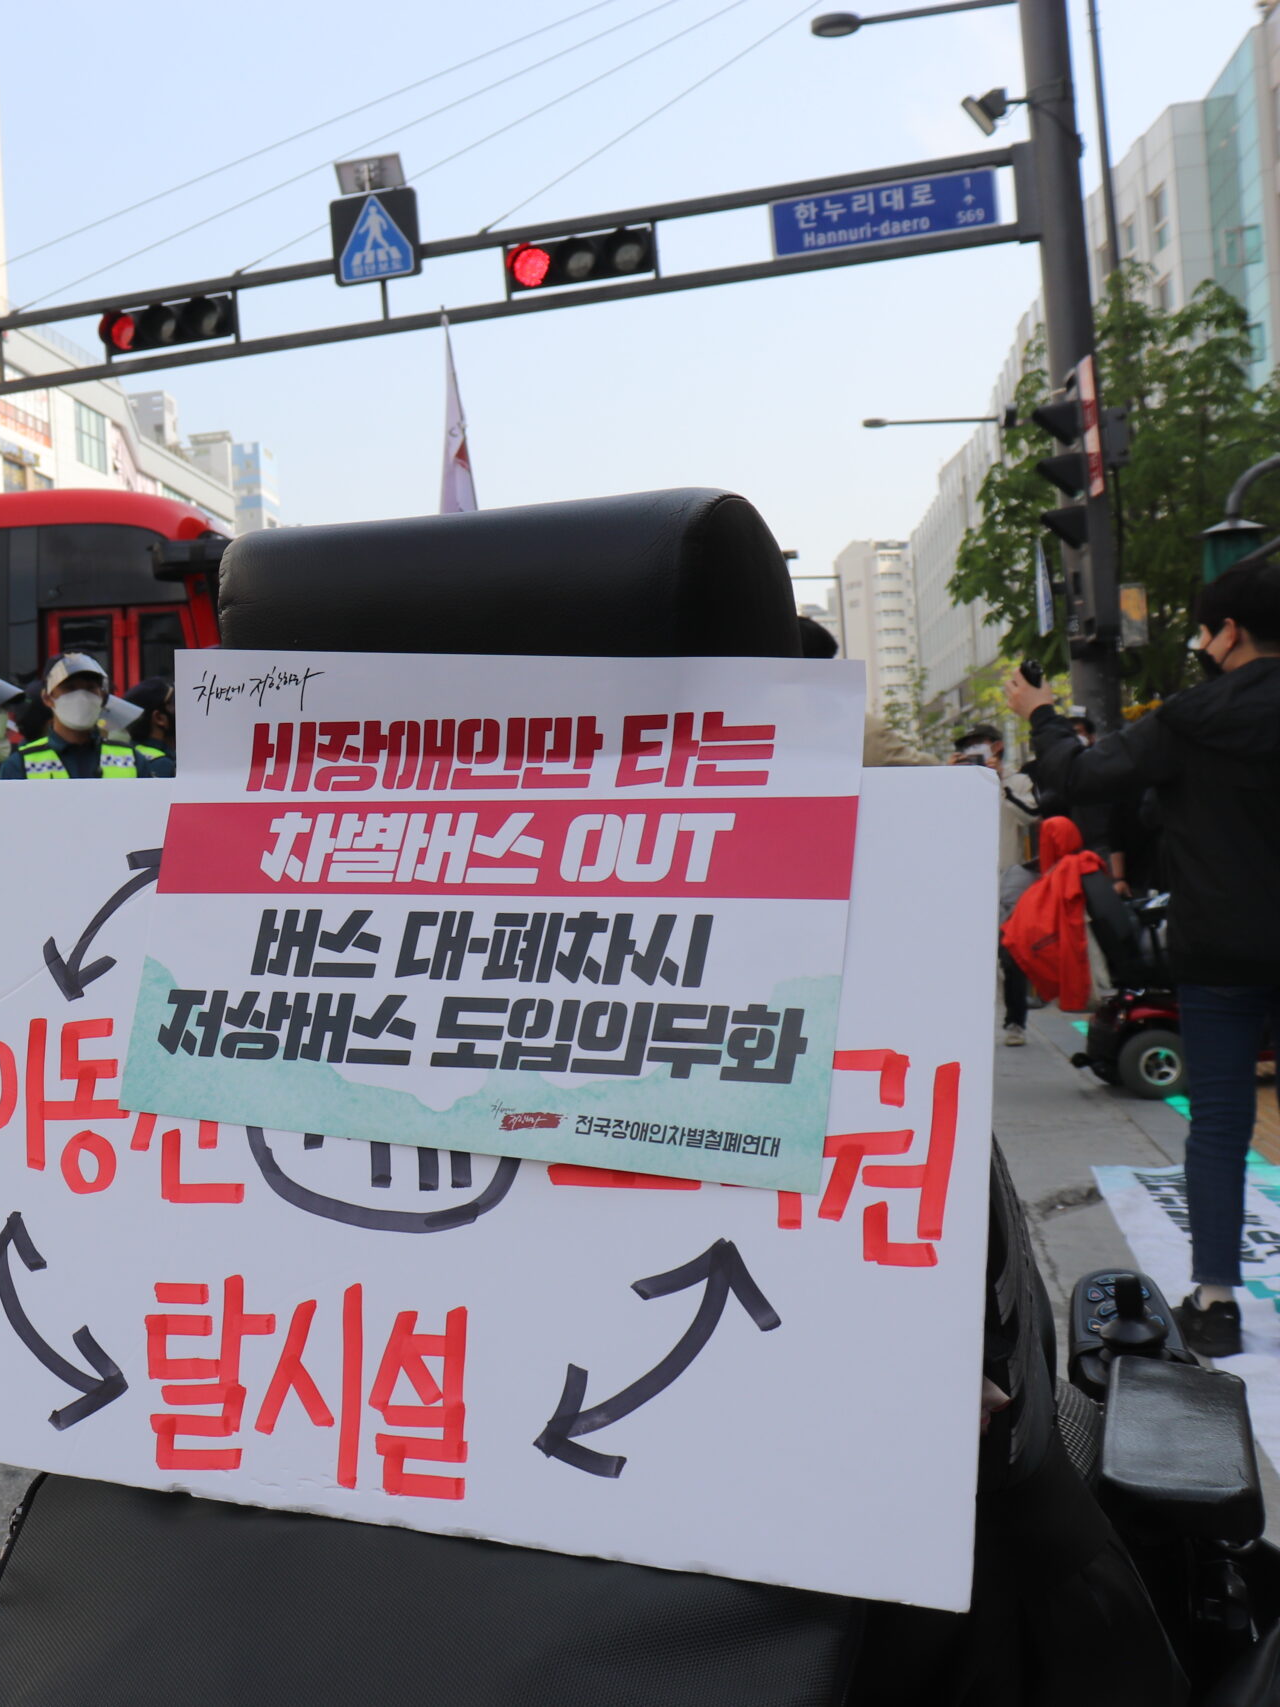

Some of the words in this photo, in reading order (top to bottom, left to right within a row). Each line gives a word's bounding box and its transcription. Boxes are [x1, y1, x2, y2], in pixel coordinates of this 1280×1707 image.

[793, 183, 936, 229] 한누리대로
[802, 216, 930, 249] Hannuri-daero
[956, 207, 986, 225] 569
[246, 715, 604, 793] 비장애인만
[615, 711, 777, 789] 타는
[260, 810, 546, 885] 차별버스
[558, 812, 737, 884] OUT
[250, 908, 382, 978] 버스
[157, 988, 417, 1067] 저상버스
[429, 996, 809, 1085] 도입의무화
[574, 1114, 782, 1158] 전국장애인차별철폐연대
[143, 1274, 469, 1502] 탈시설
